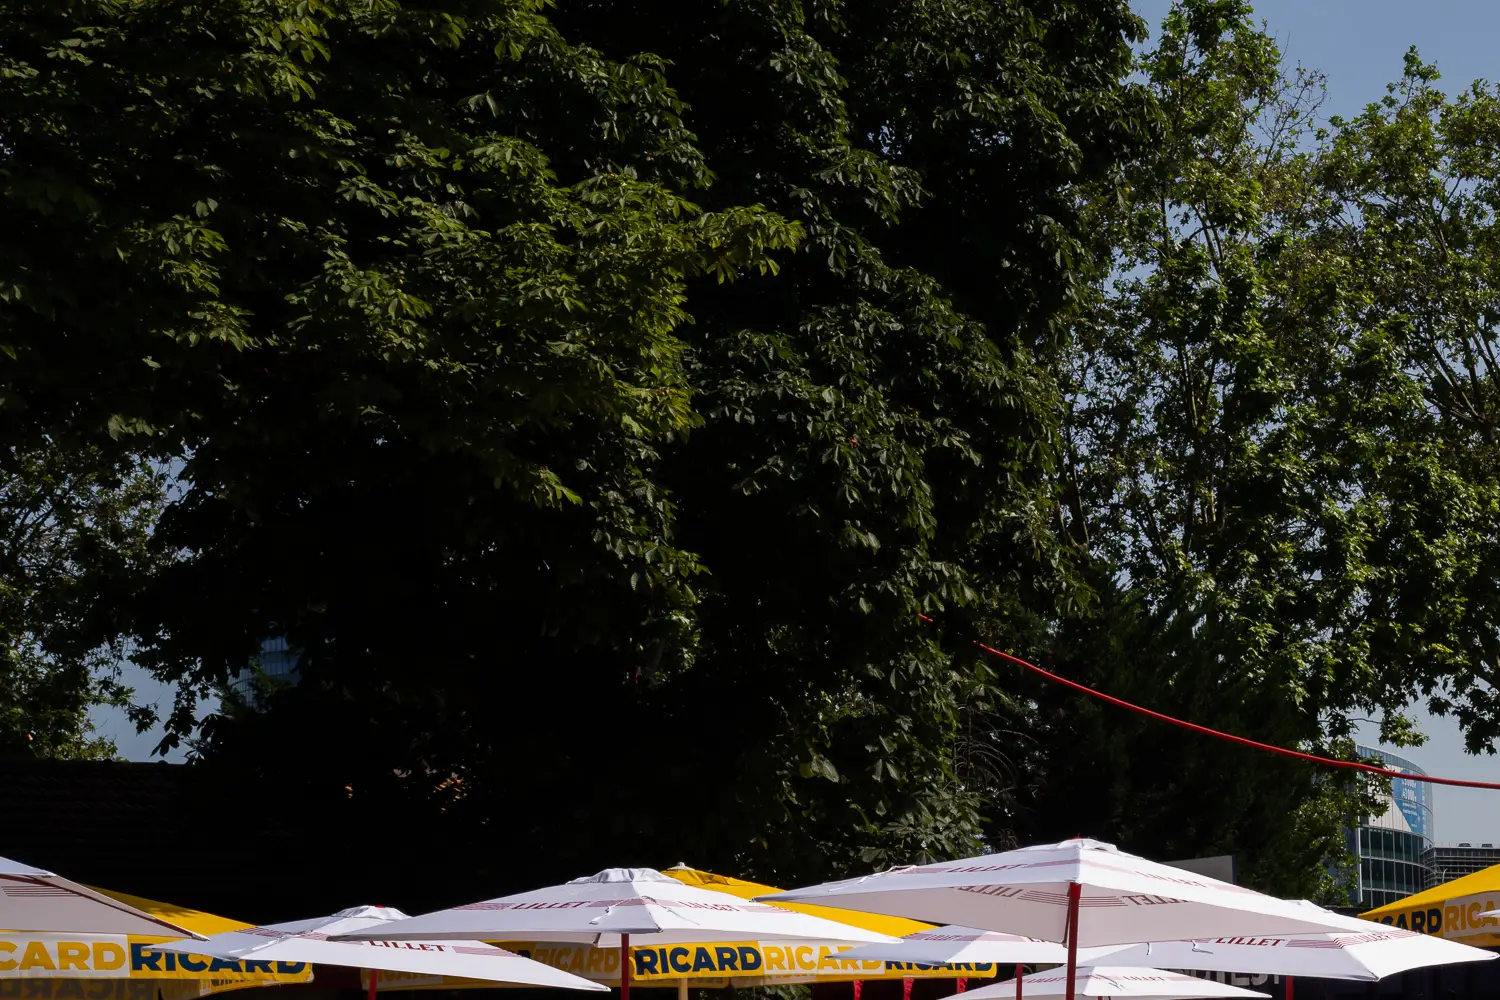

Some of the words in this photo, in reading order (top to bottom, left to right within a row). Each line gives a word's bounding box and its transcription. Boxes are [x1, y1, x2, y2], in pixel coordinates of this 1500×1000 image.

[511, 900, 591, 910] LILLET
[367, 940, 446, 952] LILLET
[1215, 937, 1286, 947] LILLET
[0, 941, 126, 971] CARD
[634, 946, 762, 976] RICARD
